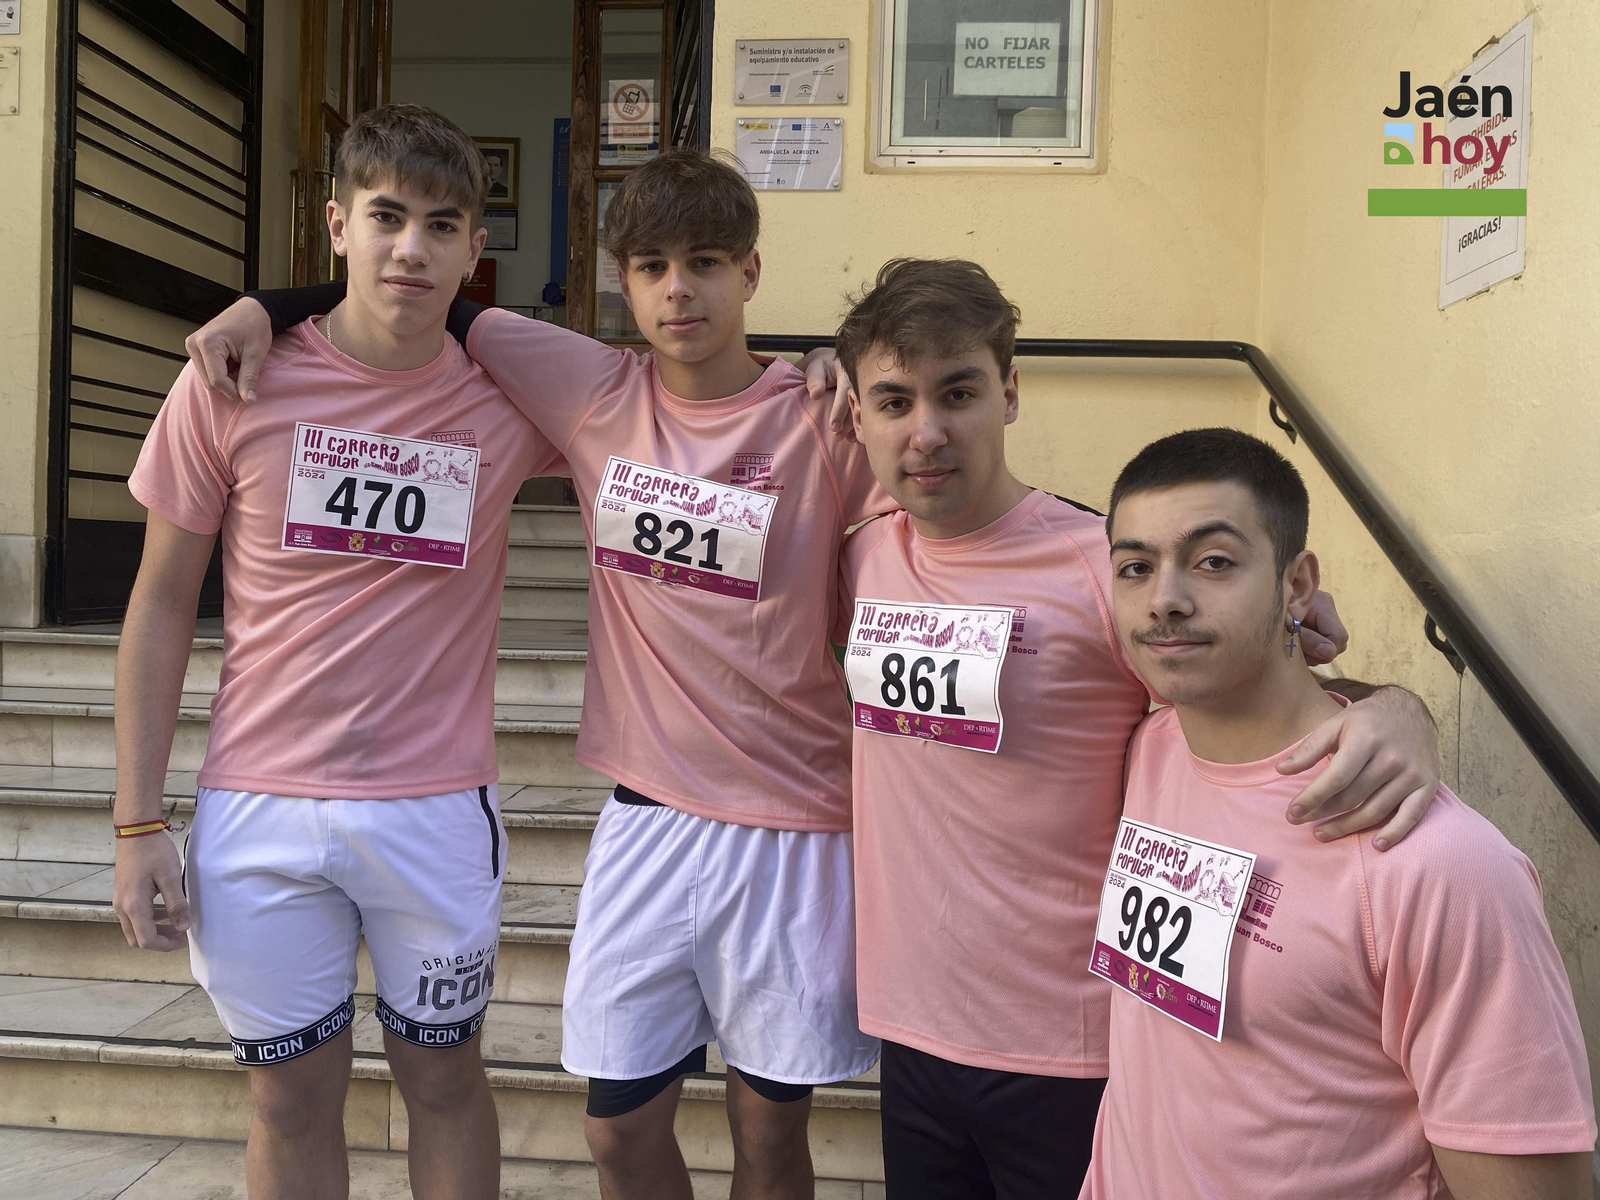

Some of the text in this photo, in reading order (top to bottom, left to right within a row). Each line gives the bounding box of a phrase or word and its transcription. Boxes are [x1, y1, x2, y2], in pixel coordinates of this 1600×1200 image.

[782, 48, 793, 56] y/o
[794, 47, 827, 55] instalación
[965, 37, 1050, 50] NO FIJAR
[749, 56, 789, 64] equipamiento
[963, 56, 1046, 69] CARTELES
[1458, 216, 1502, 252] ¡GRACIAS!
[297, 470, 325, 480] 2024
[324, 476, 426, 534] 470
[601, 502, 626, 513] 2024
[632, 511, 723, 572] 821
[850, 649, 871, 657] 2024
[1012, 646, 1037, 655] Bosco
[880, 652, 966, 716] 861
[1108, 876, 1126, 889] 2024
[1118, 885, 1193, 979] 982
[1253, 932, 1283, 953] Bosco
[417, 954, 495, 1011] ICON
[381, 1006, 406, 1036] ICON
[419, 1028, 459, 1043] ICON
[257, 1036, 304, 1061] ICON
